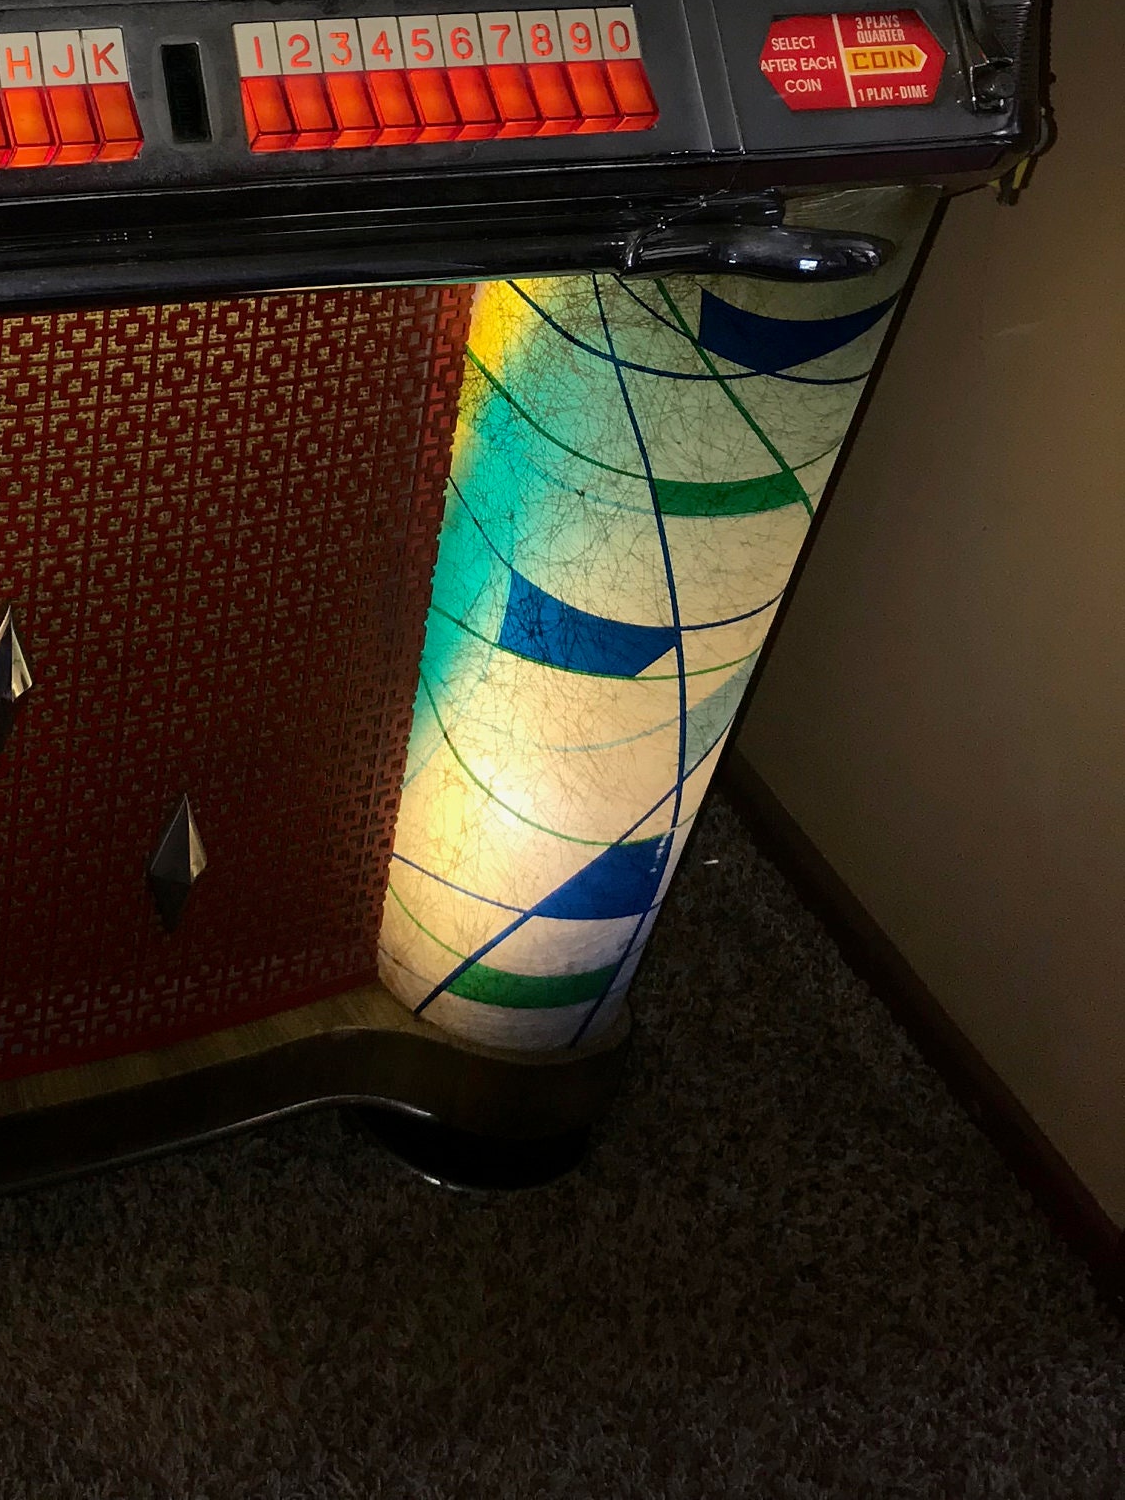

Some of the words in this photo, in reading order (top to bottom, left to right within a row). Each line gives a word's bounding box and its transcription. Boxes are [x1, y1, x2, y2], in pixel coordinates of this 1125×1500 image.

[855, 16, 863, 30] 3
[866, 15, 900, 29] PLAYS
[771, 36, 815, 51] SELECT
[857, 28, 905, 44] QUARTER
[253, 36, 263, 69] 1
[288, 34, 312, 68] 2
[329, 32, 353, 66] 3
[372, 30, 393, 63] 4
[411, 27, 434, 62] 5
[450, 26, 473, 60] 6
[489, 24, 511, 58] 7
[530, 23, 553, 57] 8
[569, 22, 592, 55] 9
[608, 20, 631, 52] 0
[6, 45, 31, 81] H
[52, 44, 75, 78] J
[92, 42, 120, 77] K
[761, 58, 798, 73] AFTER
[801, 56, 837, 71] EACH
[853, 50, 917, 70] COIN
[785, 78, 823, 93] COIN
[858, 88, 865, 102] 1
